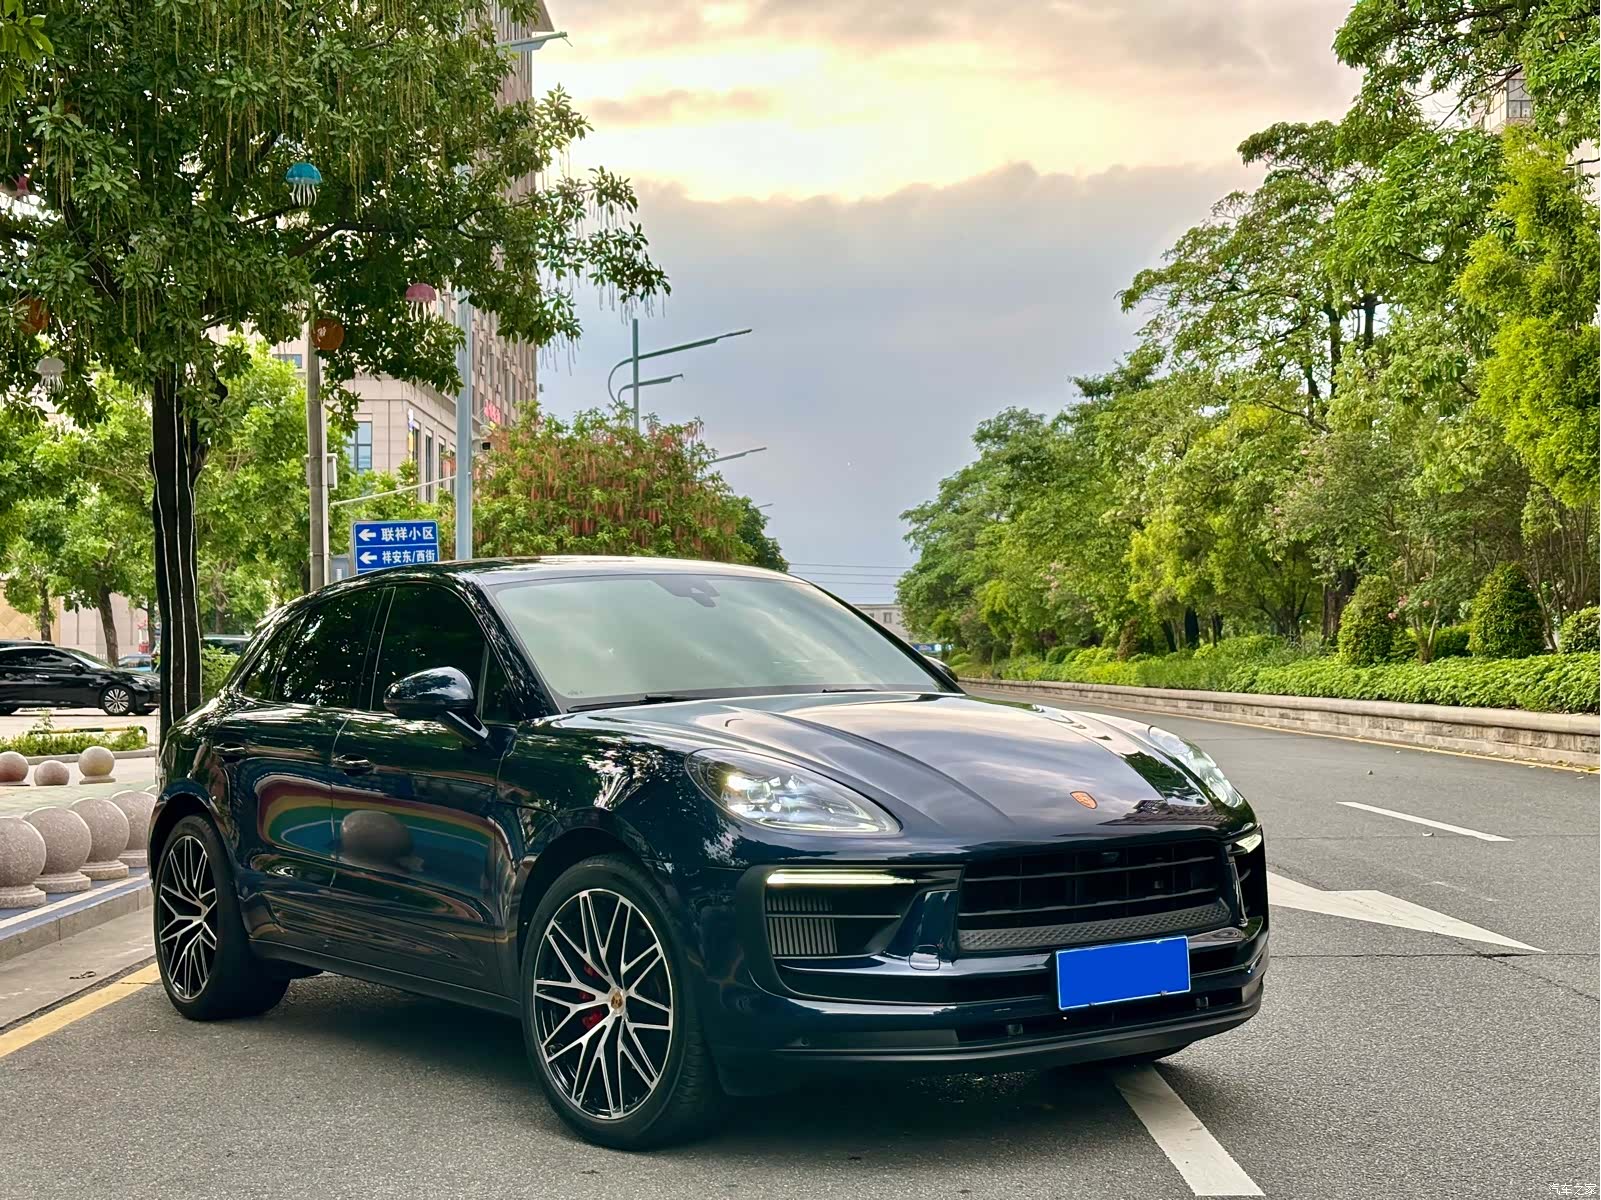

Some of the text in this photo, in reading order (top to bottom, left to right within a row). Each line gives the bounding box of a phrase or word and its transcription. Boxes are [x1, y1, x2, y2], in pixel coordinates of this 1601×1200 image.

[381, 526, 435, 542] 联祥小区
[382, 549, 436, 565] 祥安东/西街
